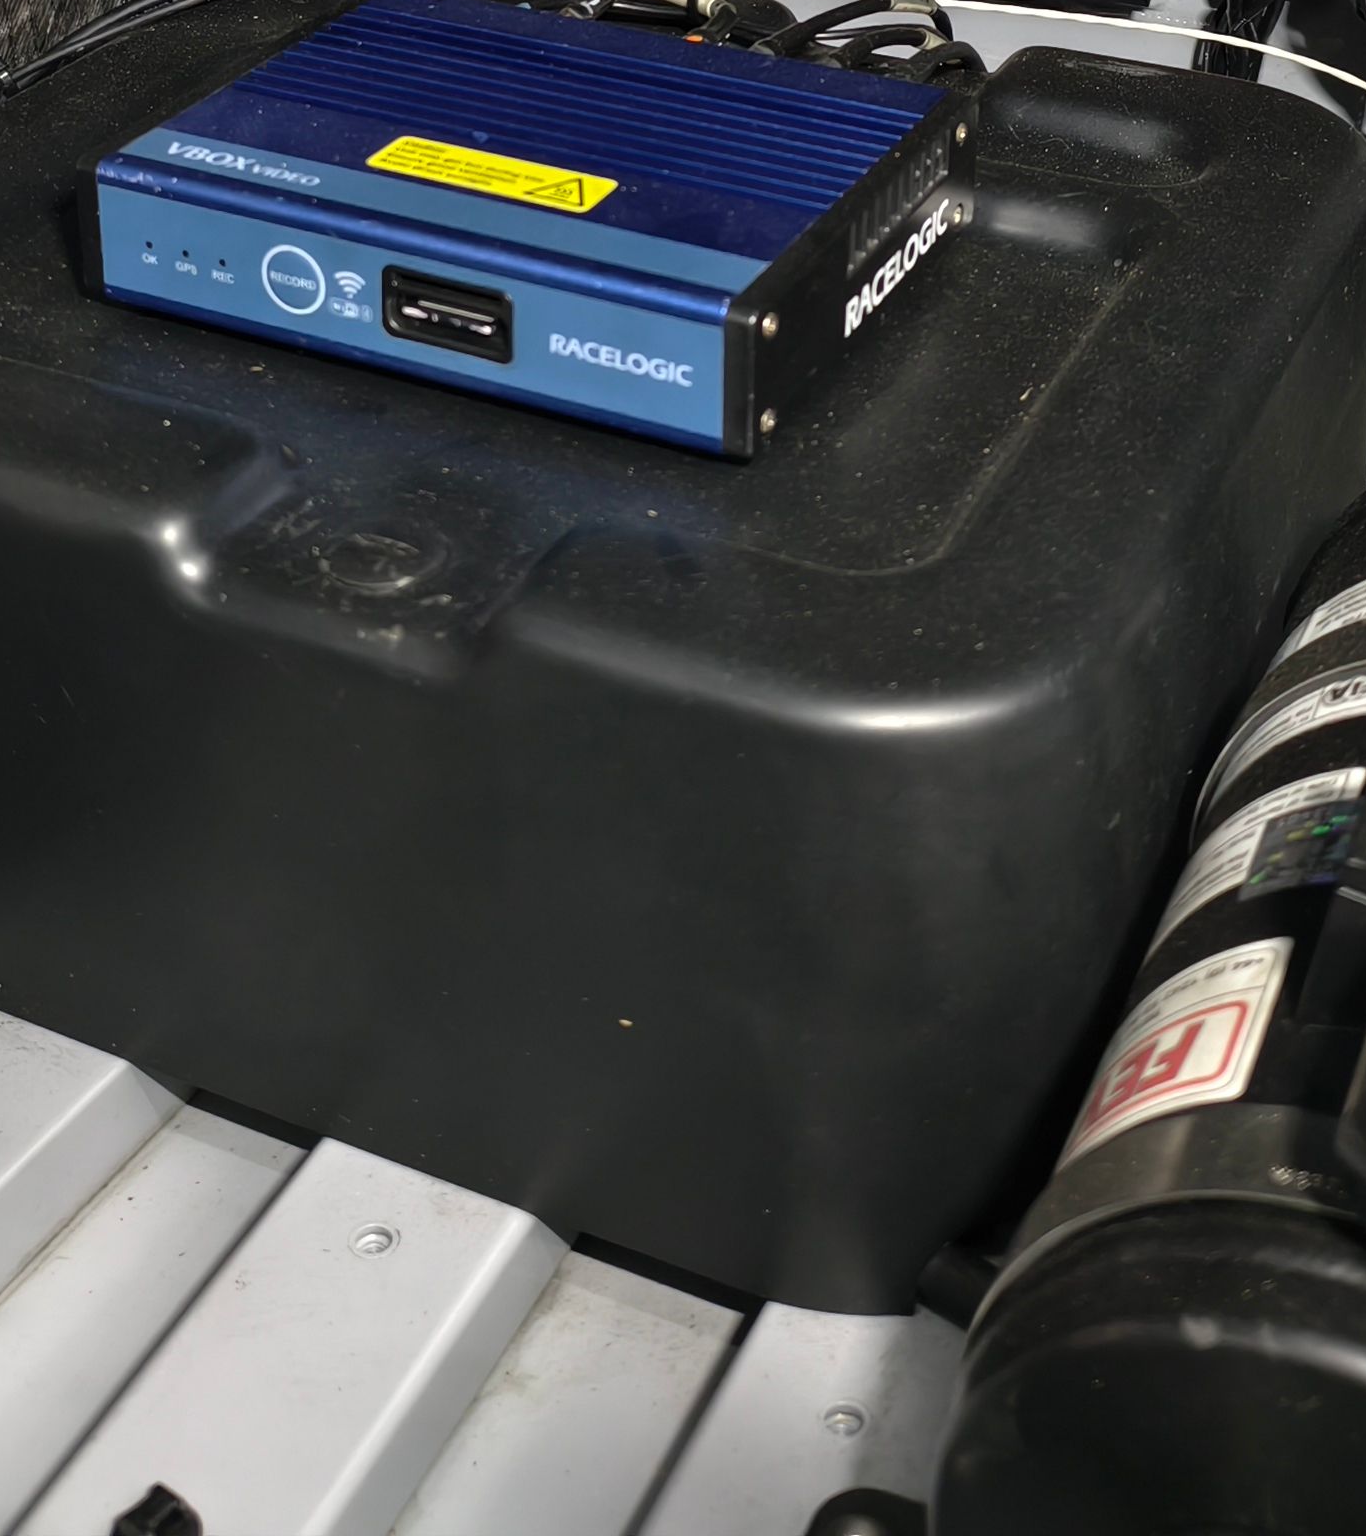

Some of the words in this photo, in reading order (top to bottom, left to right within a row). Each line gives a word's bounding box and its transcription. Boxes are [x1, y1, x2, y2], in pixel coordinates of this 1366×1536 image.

[167, 141, 254, 170] VBOX
[253, 162, 321, 187] VIDEO
[142, 253, 158, 265] OK
[175, 261, 198, 276] GPS
[843, 198, 951, 339] RACELOGIC
[211, 269, 235, 285] REC
[270, 270, 317, 291] RECORD
[549, 332, 694, 388] RACELOGIC
